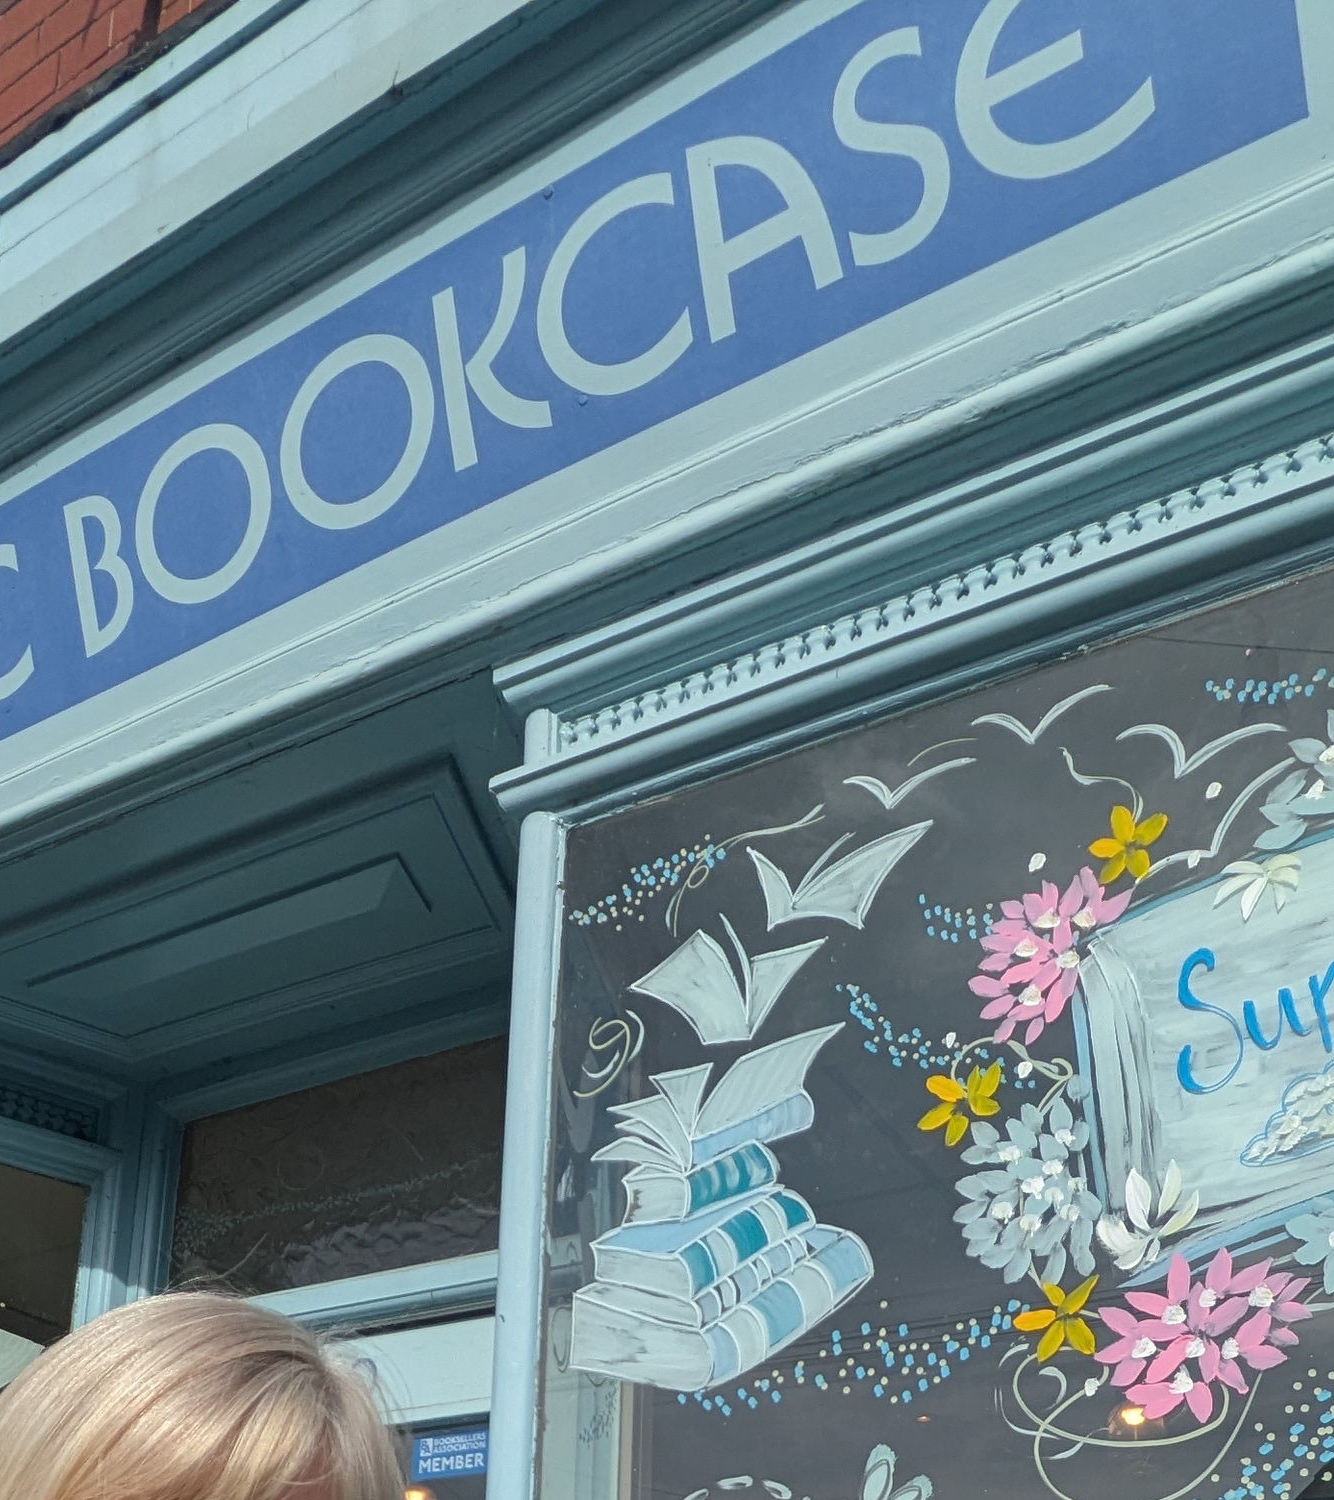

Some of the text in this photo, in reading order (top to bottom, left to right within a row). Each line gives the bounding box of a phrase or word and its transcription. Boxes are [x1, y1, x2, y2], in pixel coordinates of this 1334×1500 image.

[64, 0, 1156, 658] BOOKCASE
[433, 1432, 486, 1446] BOOKSELLERS
[433, 1440, 486, 1454] ASSOCIATION
[418, 1452, 485, 1474] MEMBER
